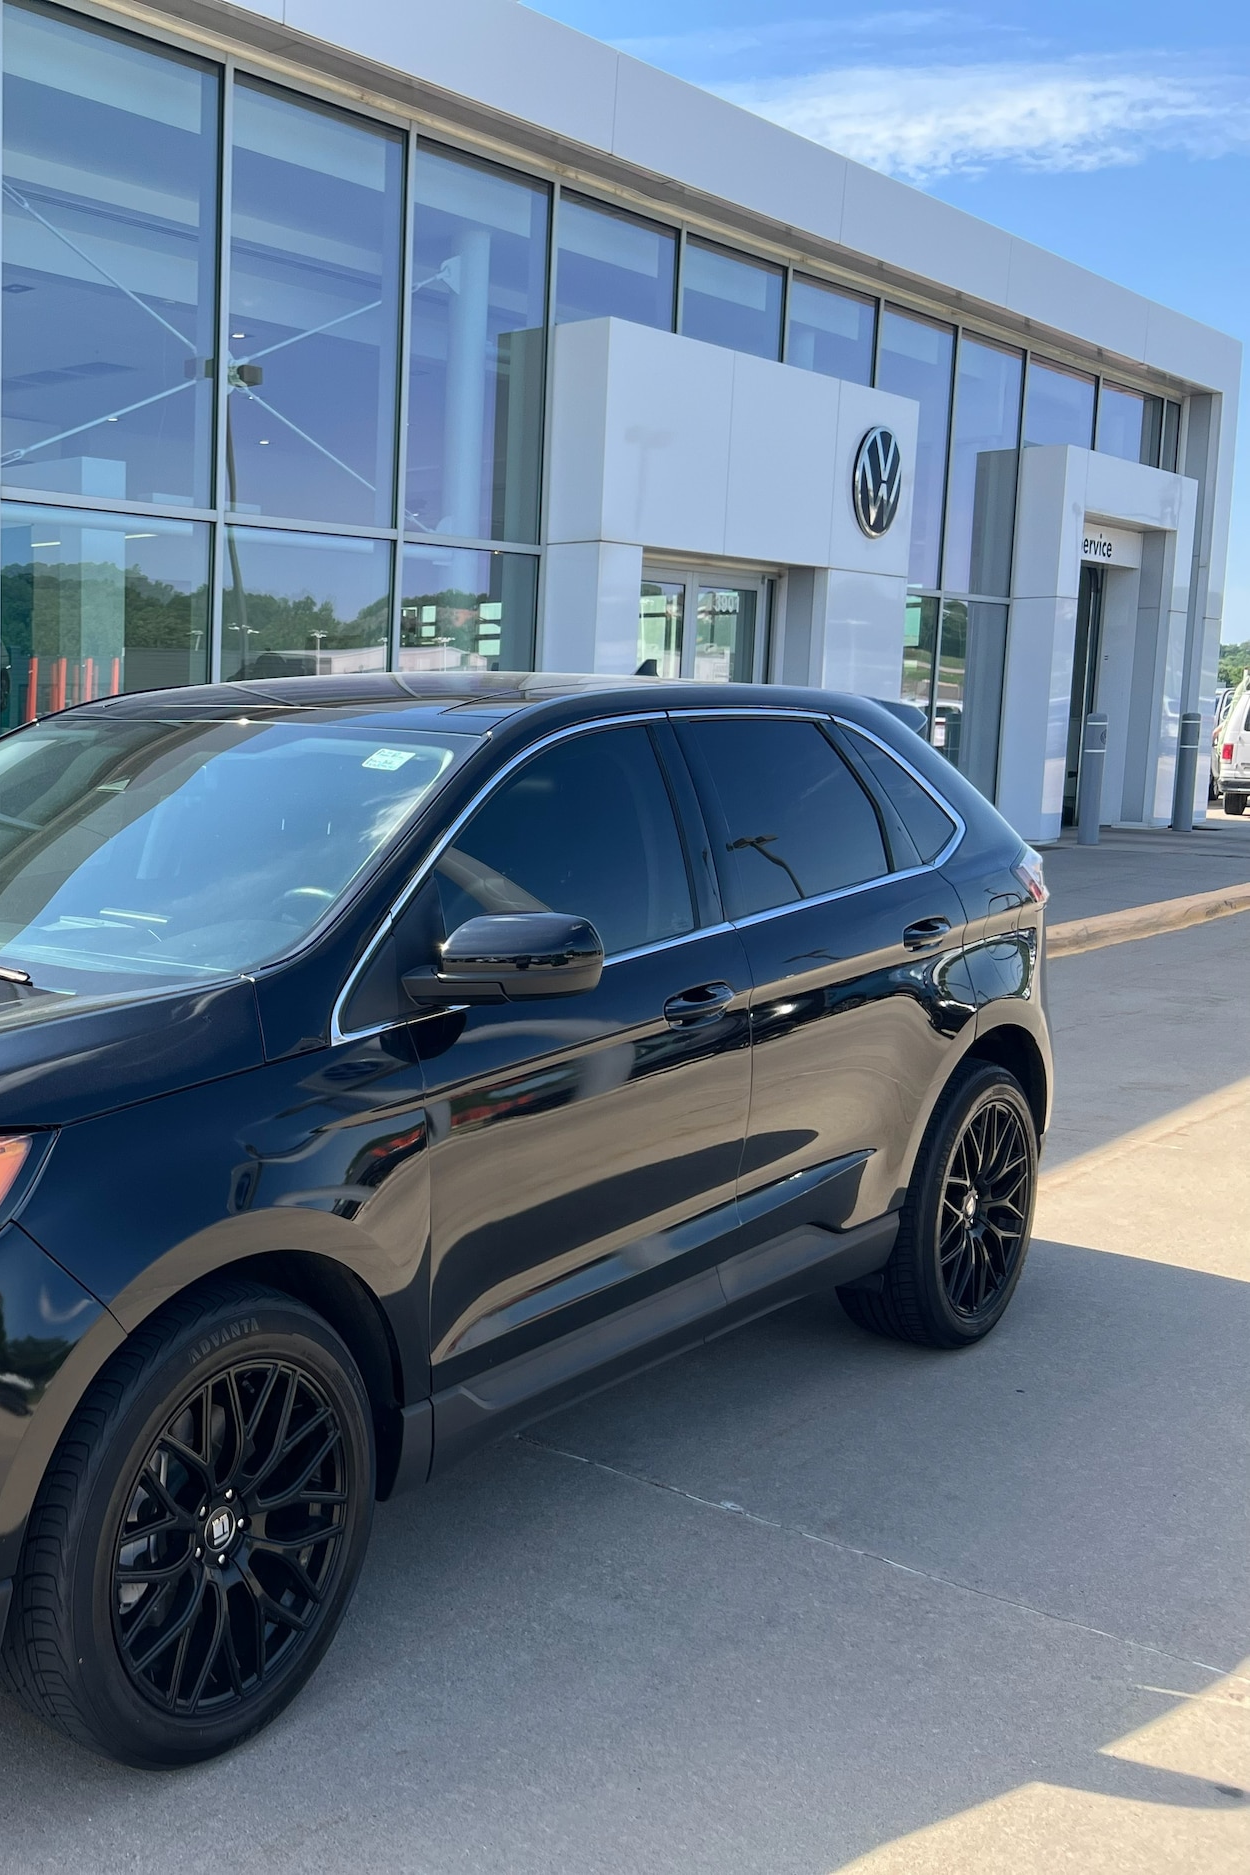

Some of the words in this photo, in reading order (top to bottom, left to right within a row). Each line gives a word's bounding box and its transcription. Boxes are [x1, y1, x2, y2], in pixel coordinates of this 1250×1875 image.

[1082, 533, 1112, 558] ervice
[714, 593, 740, 613] 3901
[188, 1317, 260, 1364] ADVANTA
